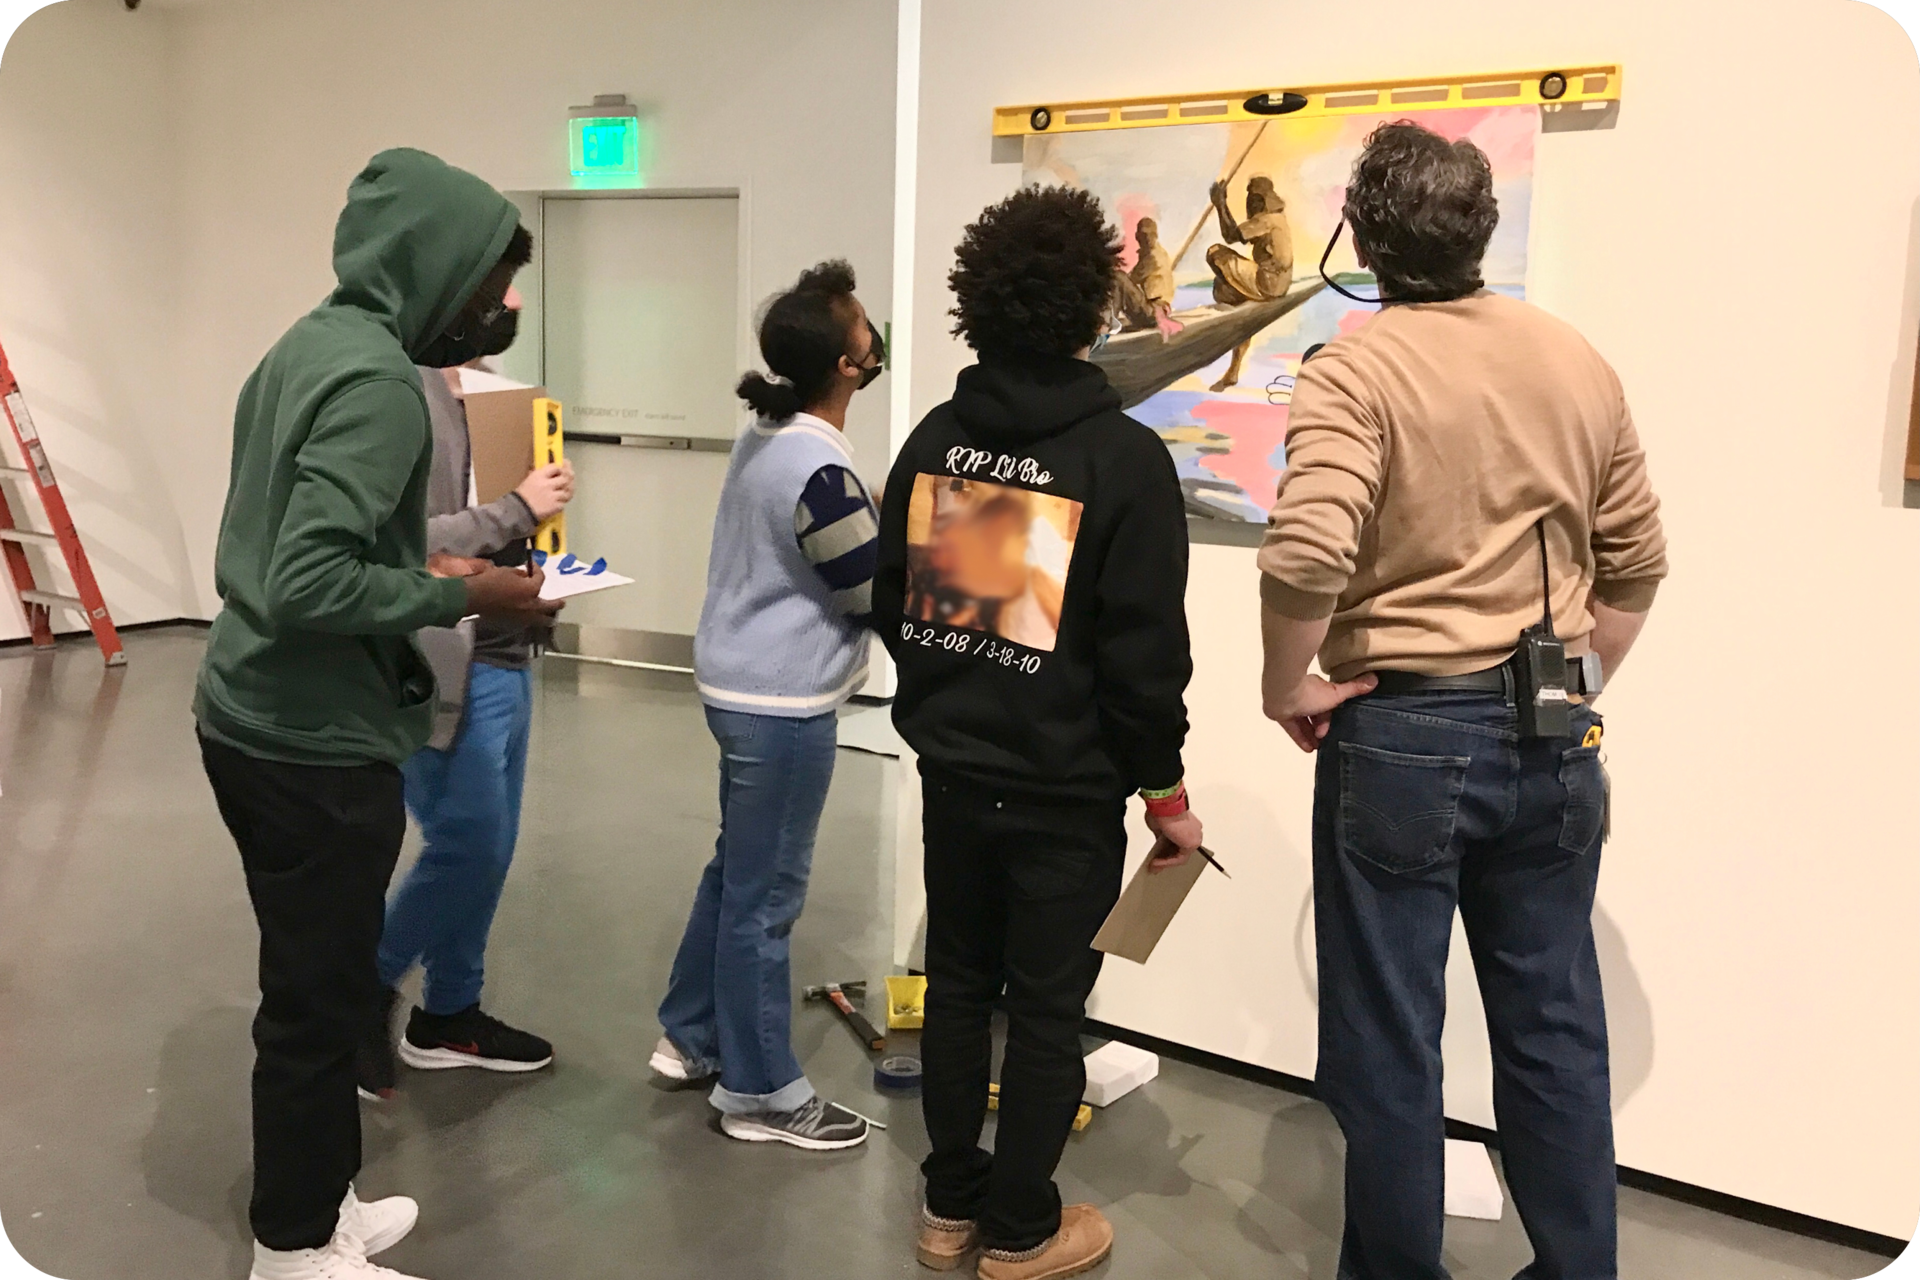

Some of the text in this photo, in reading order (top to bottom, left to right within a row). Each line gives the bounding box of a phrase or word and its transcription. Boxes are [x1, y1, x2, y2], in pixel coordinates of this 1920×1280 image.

[583, 126, 626, 167] EXIT
[946, 446, 1054, 485] RIP Lil Bro
[901, 622, 1041, 674] 10-2-08 / 3-18-10
